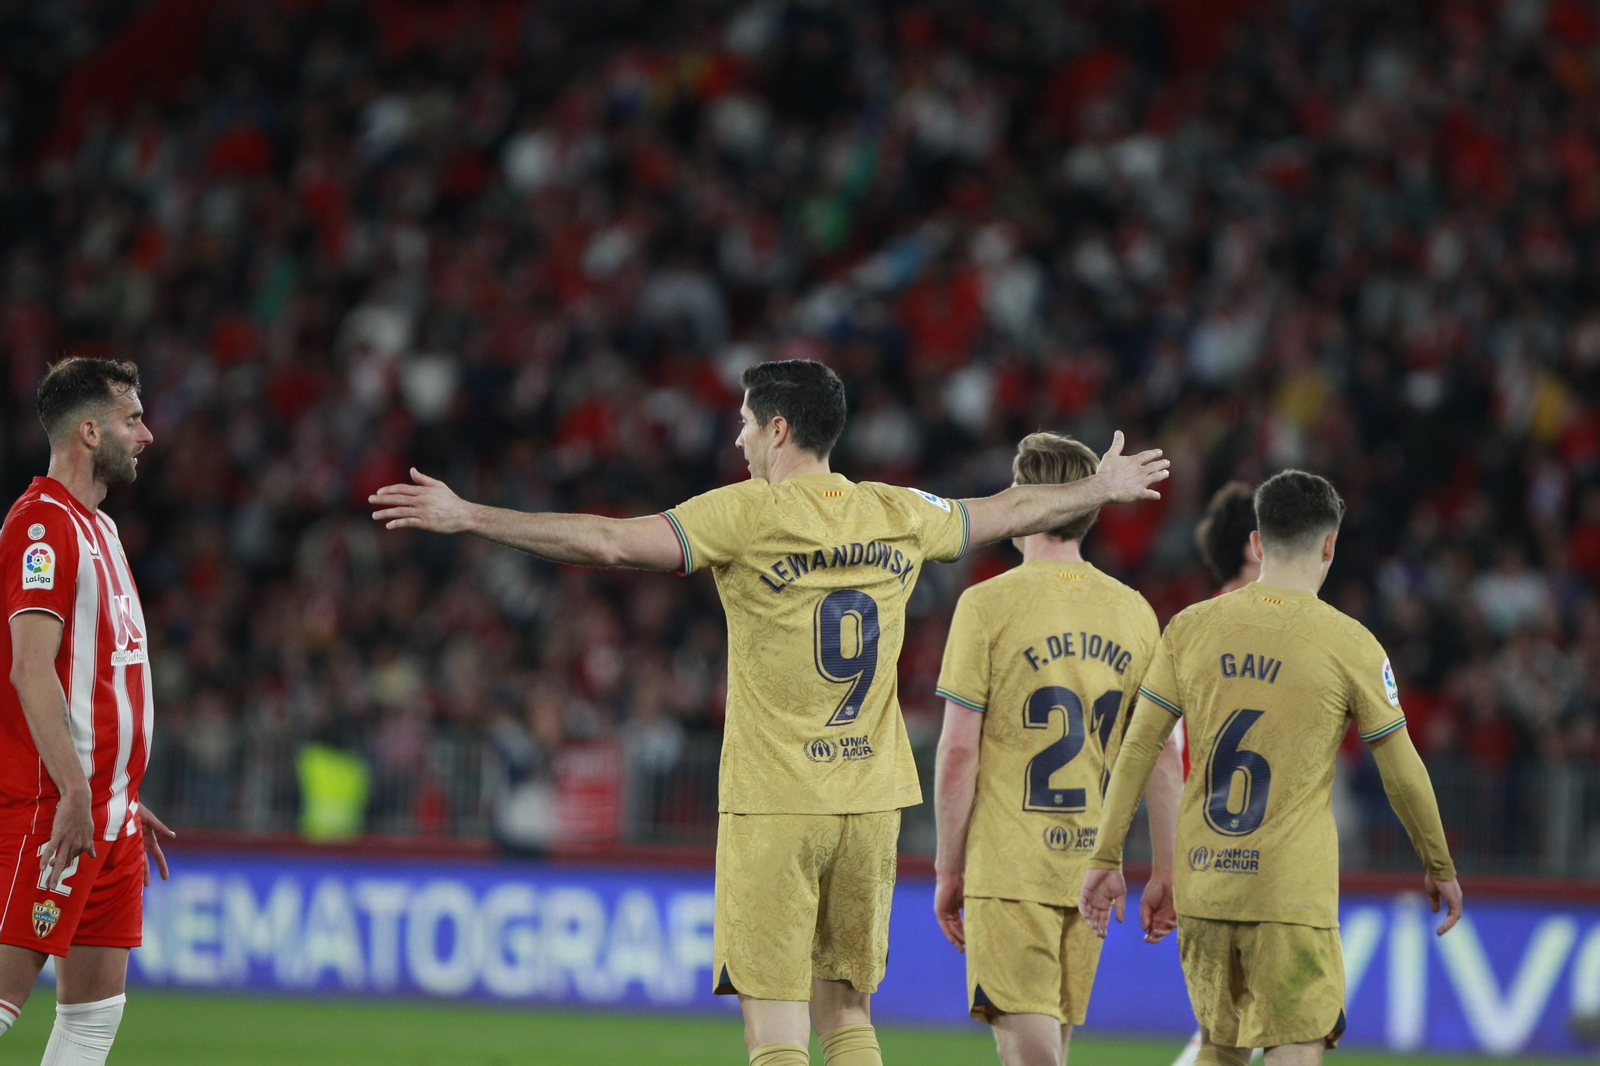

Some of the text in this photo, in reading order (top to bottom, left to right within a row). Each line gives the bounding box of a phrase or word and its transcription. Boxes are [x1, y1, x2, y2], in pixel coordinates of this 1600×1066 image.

[25, 574, 51, 584] LaLiga
[814, 589, 881, 727] 9
[1079, 632, 1132, 676] JONG
[1220, 653, 1282, 684] GAVI
[840, 735, 869, 747] UNR
[1022, 685, 1124, 814] 21
[1203, 708, 1272, 838] 6
[1077, 827, 1099, 838] UNH
[1075, 838, 1096, 848] ACN
[1216, 848, 1260, 860] UNHCR
[1214, 859, 1259, 870] ACNUR
